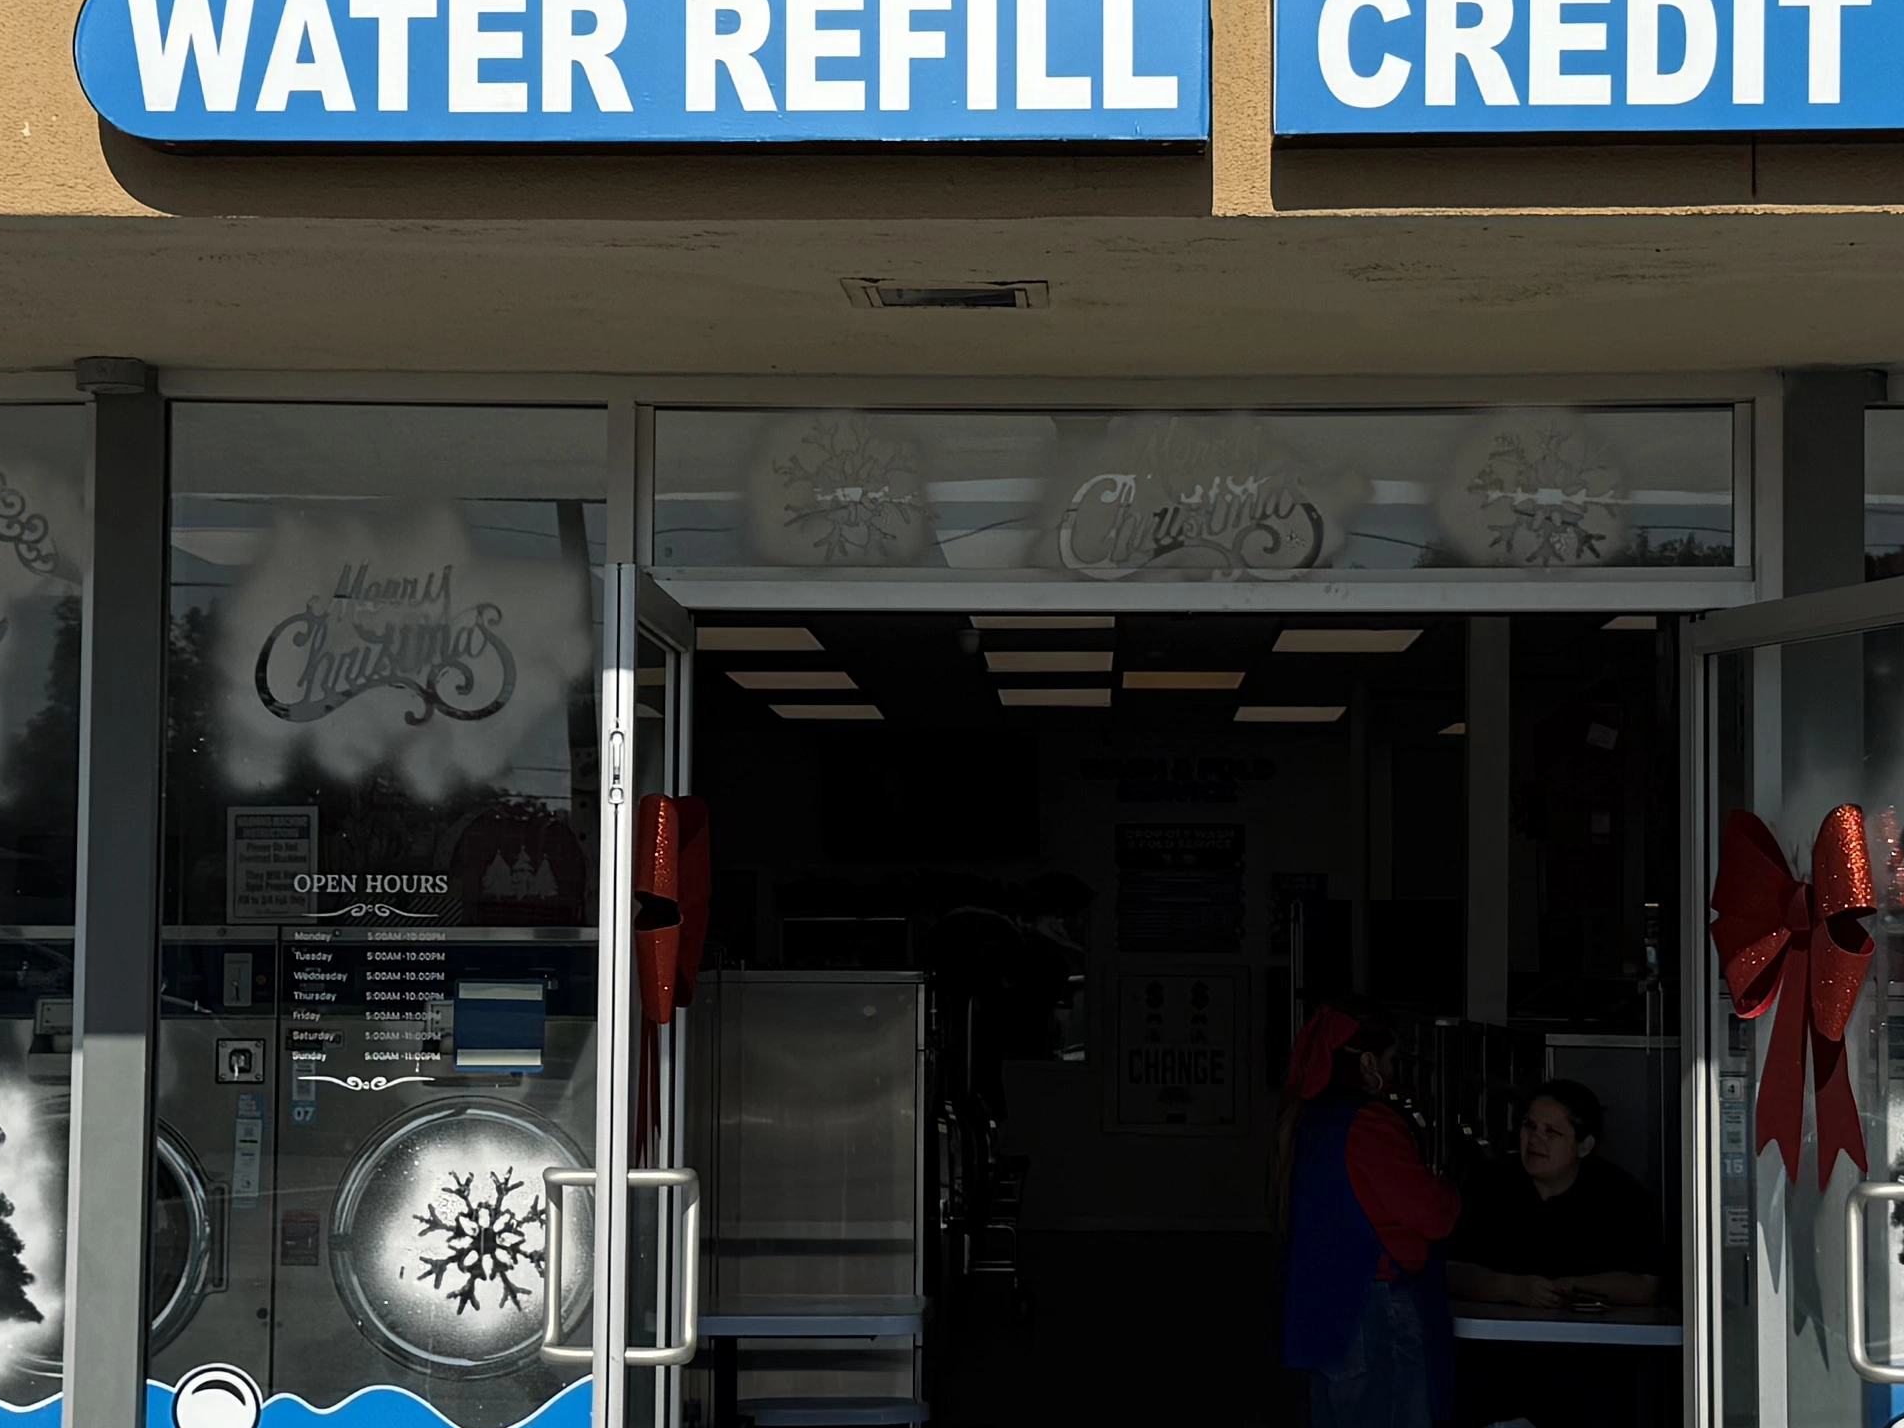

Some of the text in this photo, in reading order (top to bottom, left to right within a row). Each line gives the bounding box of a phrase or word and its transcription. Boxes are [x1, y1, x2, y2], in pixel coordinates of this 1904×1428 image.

[294, 874, 448, 893] OPEN HOURS
[294, 952, 333, 963] Tuesday
[293, 972, 348, 983] Wednesday
[294, 992, 337, 1002] Thursday
[1128, 1050, 1224, 1084] CHANGE
[294, 1107, 313, 1121] 07
